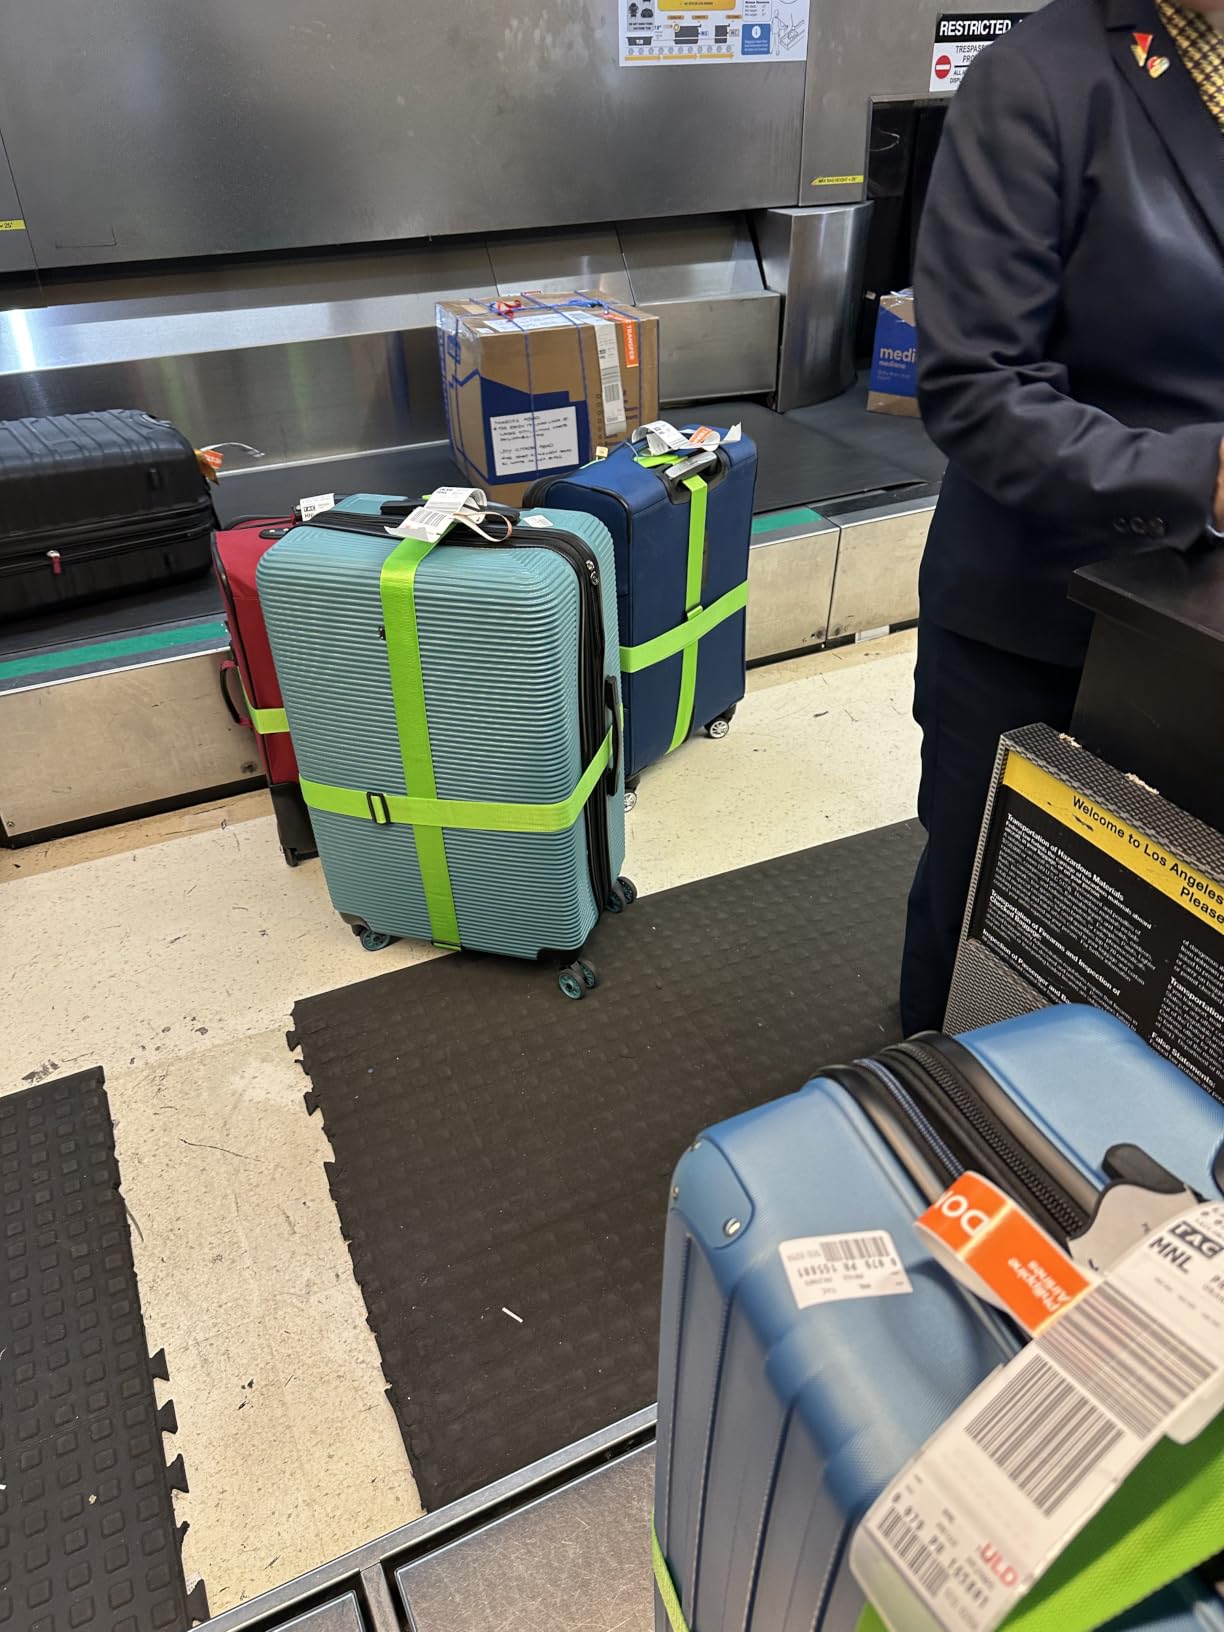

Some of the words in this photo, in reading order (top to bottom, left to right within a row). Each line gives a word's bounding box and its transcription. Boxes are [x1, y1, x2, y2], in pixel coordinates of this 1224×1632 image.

[940, 20, 1012, 36] RESTRICTED
[1008, 813, 1050, 848] Transportation
[1050, 845, 1058, 853] of
[1058, 849, 1092, 878] Hazardous
[1092, 874, 1124, 901] Materials
[1073, 795, 1125, 838] Welcome
[1128, 834, 1140, 848] to
[1144, 843, 1167, 866] Los
[1169, 863, 1224, 905] Angeles
[990, 895, 1014, 918] Checked
[1180, 886, 1224, 924] Please
[983, 929, 1011, 955] Inspection
[1018, 958, 1048, 986] Passenger
[1048, 985, 1061, 997] and
[991, 889, 1031, 925] Transportation
[1039, 927, 1065, 952] Firearms
[1065, 950, 1078, 962] and
[1078, 959, 1112, 989] Inspection
[1112, 988, 1120, 996] of
[1171, 976, 1224, 1022] Transportation
[1151, 1032, 1171, 1051] False
[1171, 1048, 1215, 1088] Statements:
[1149, 1237, 1192, 1273] MNL
[1007, 1257, 1061, 1312] Philippine
[1027, 1261, 1070, 1301] Airlines
[980, 1541, 1018, 1587] ULD
